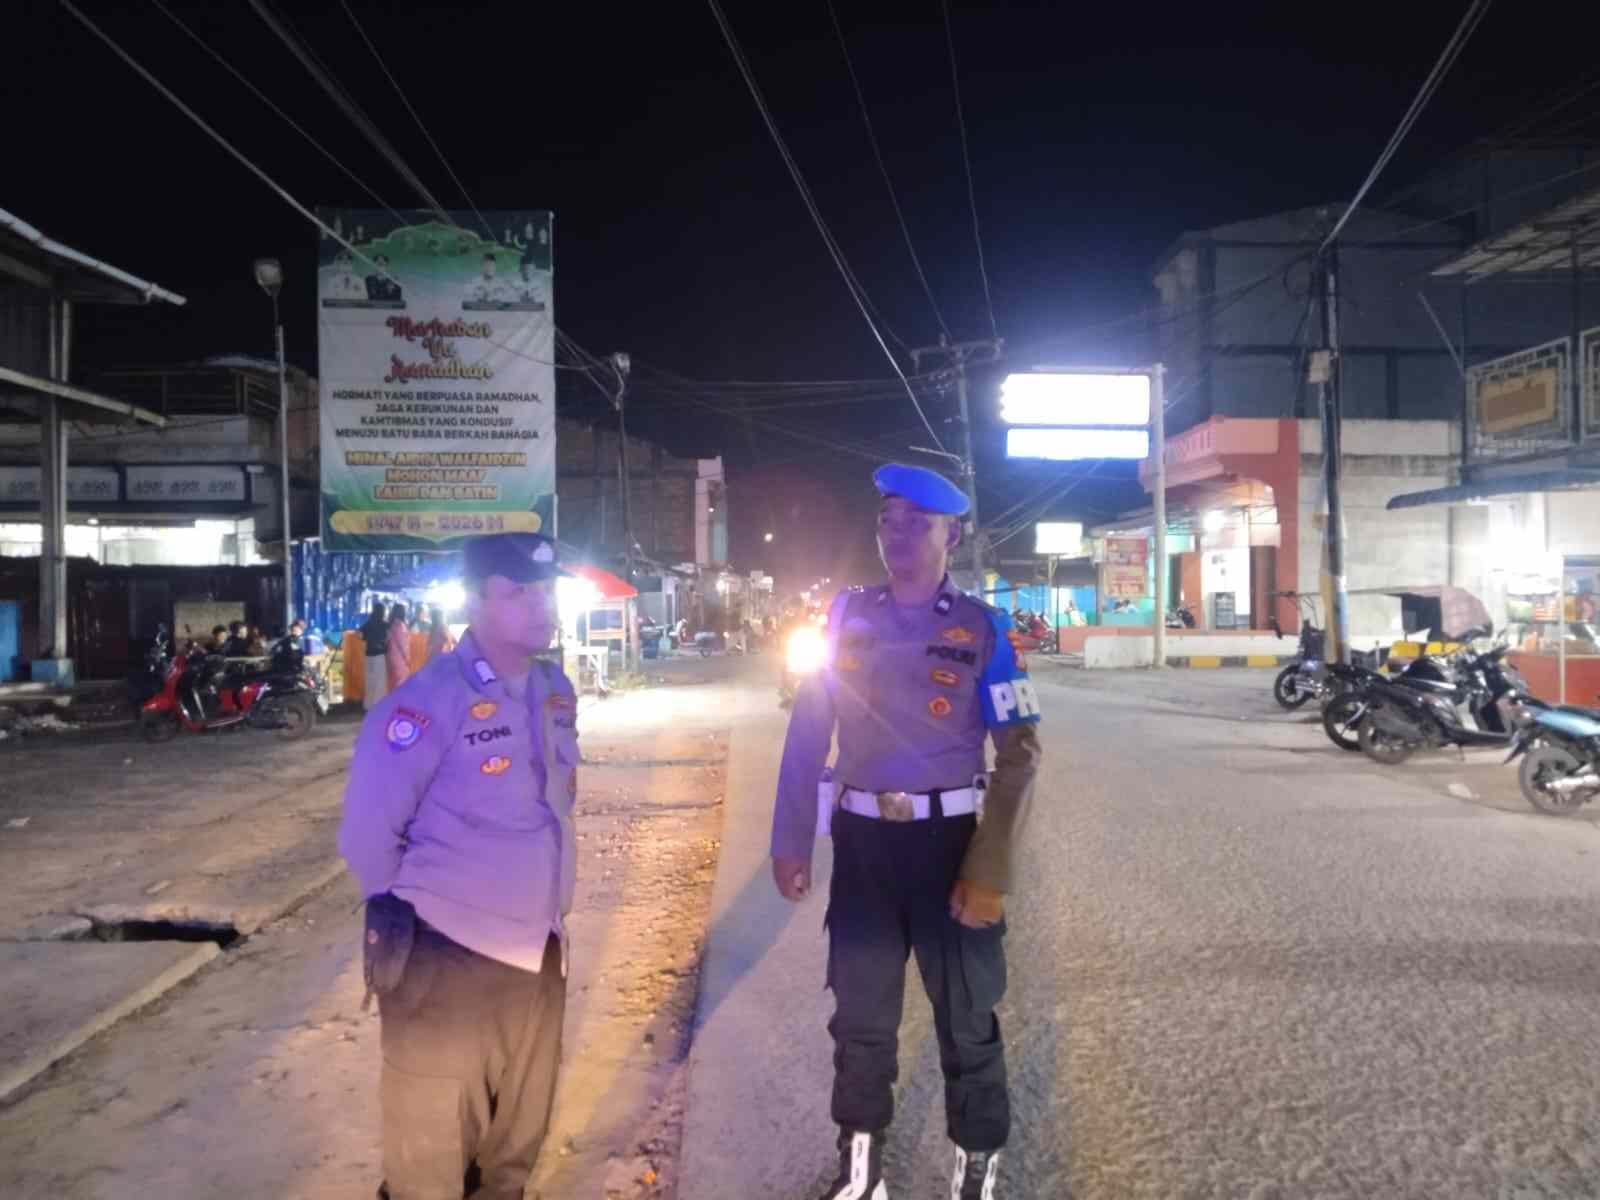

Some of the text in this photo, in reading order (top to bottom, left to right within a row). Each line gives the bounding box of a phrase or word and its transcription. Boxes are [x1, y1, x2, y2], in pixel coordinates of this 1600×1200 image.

[333, 391, 542, 403] HORMATI YANG BERPUASA RAMADHAN,
[376, 403, 499, 414] JAGA KERUKUNAN DAN
[360, 415, 513, 427] KAMTIBMAS YANG KONDUSIF
[336, 428, 539, 440] MENUJU BATU BARA BERKAH BAHAGIA
[927, 645, 977, 666] POLRI
[464, 726, 512, 746] TONI
